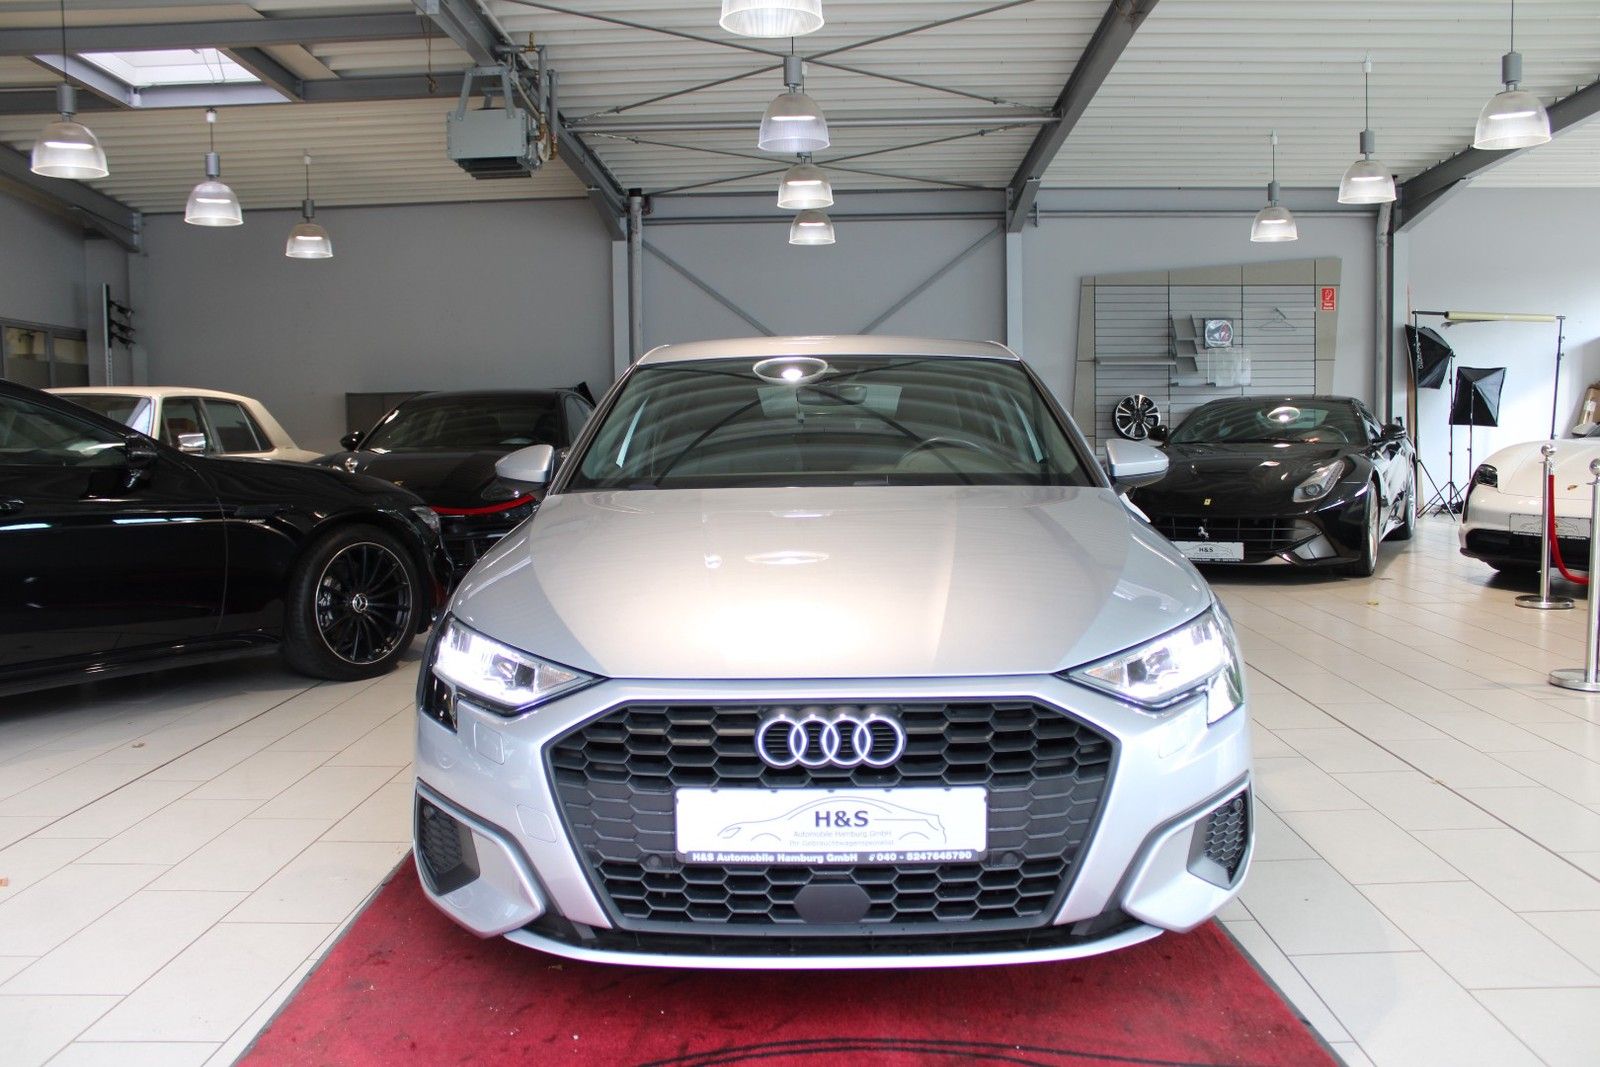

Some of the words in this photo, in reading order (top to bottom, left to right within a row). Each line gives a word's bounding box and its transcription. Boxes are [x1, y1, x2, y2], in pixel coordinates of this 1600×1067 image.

[815, 810, 869, 828] H&S
[835, 831, 867, 839] Hamburg
[692, 853, 715, 862] H&S
[717, 852, 775, 862] Automobile
[777, 852, 824, 864] Hamburg
[826, 852, 858, 862] GmbH
[876, 852, 897, 861] 040
